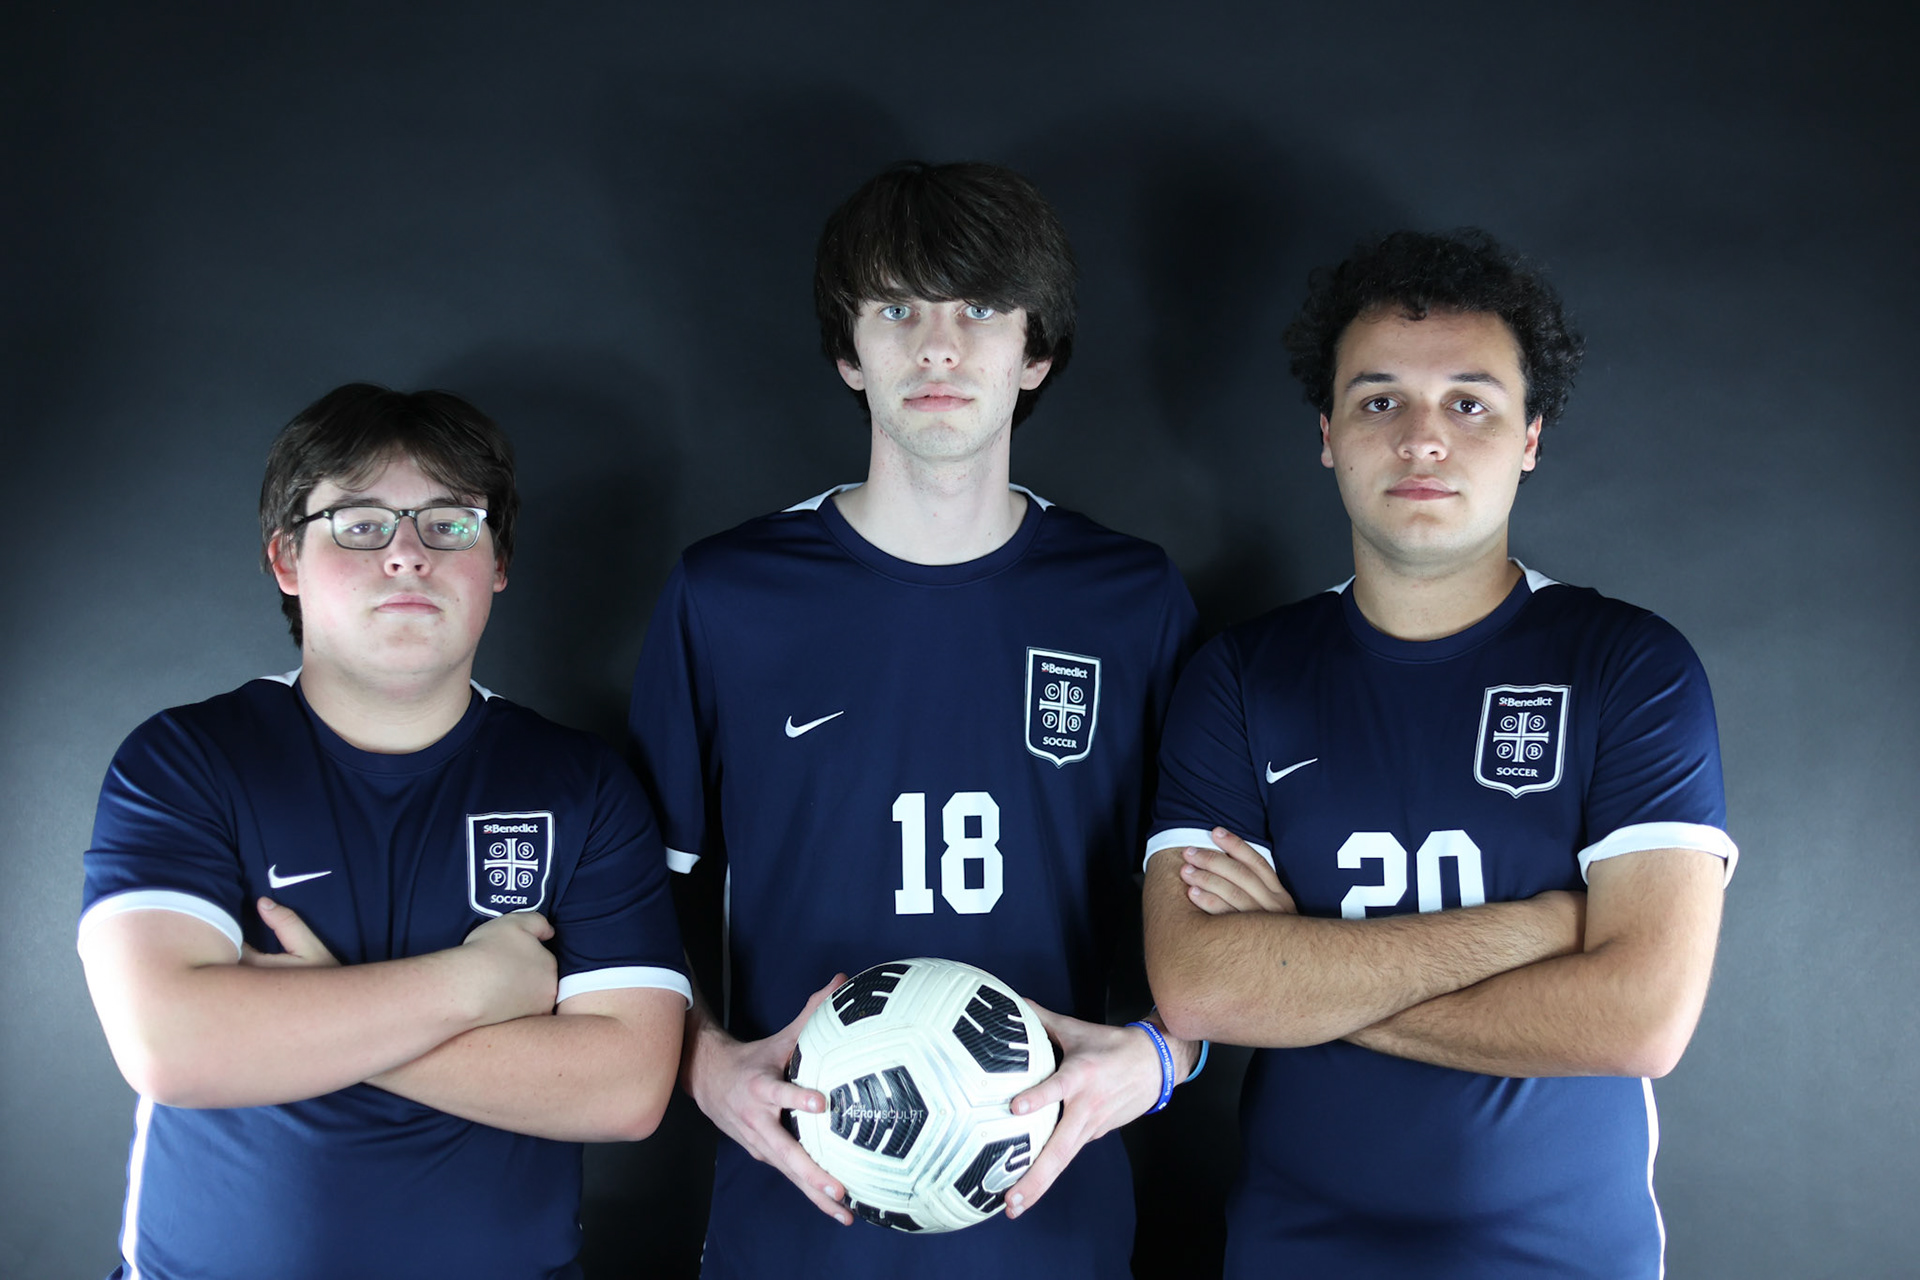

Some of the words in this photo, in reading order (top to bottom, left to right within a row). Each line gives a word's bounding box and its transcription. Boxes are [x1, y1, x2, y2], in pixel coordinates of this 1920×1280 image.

[1047, 685, 1057, 697] C
[1072, 689, 1080, 701] S
[1046, 714, 1054, 726] P
[1070, 717, 1078, 729] B
[1503, 718, 1513, 729] C
[1532, 718, 1541, 728] S
[1042, 736, 1078, 749] SOCCER
[1500, 745, 1510, 756] P
[1529, 746, 1539, 757] B
[1496, 767, 1538, 778] SOCCER
[492, 845, 503, 856] C
[522, 845, 530, 856] S
[892, 791, 1004, 915] 18
[493, 872, 503, 883] P
[521, 874, 530, 885] B
[1337, 829, 1486, 920] 20
[490, 894, 528, 905] SOCCER
